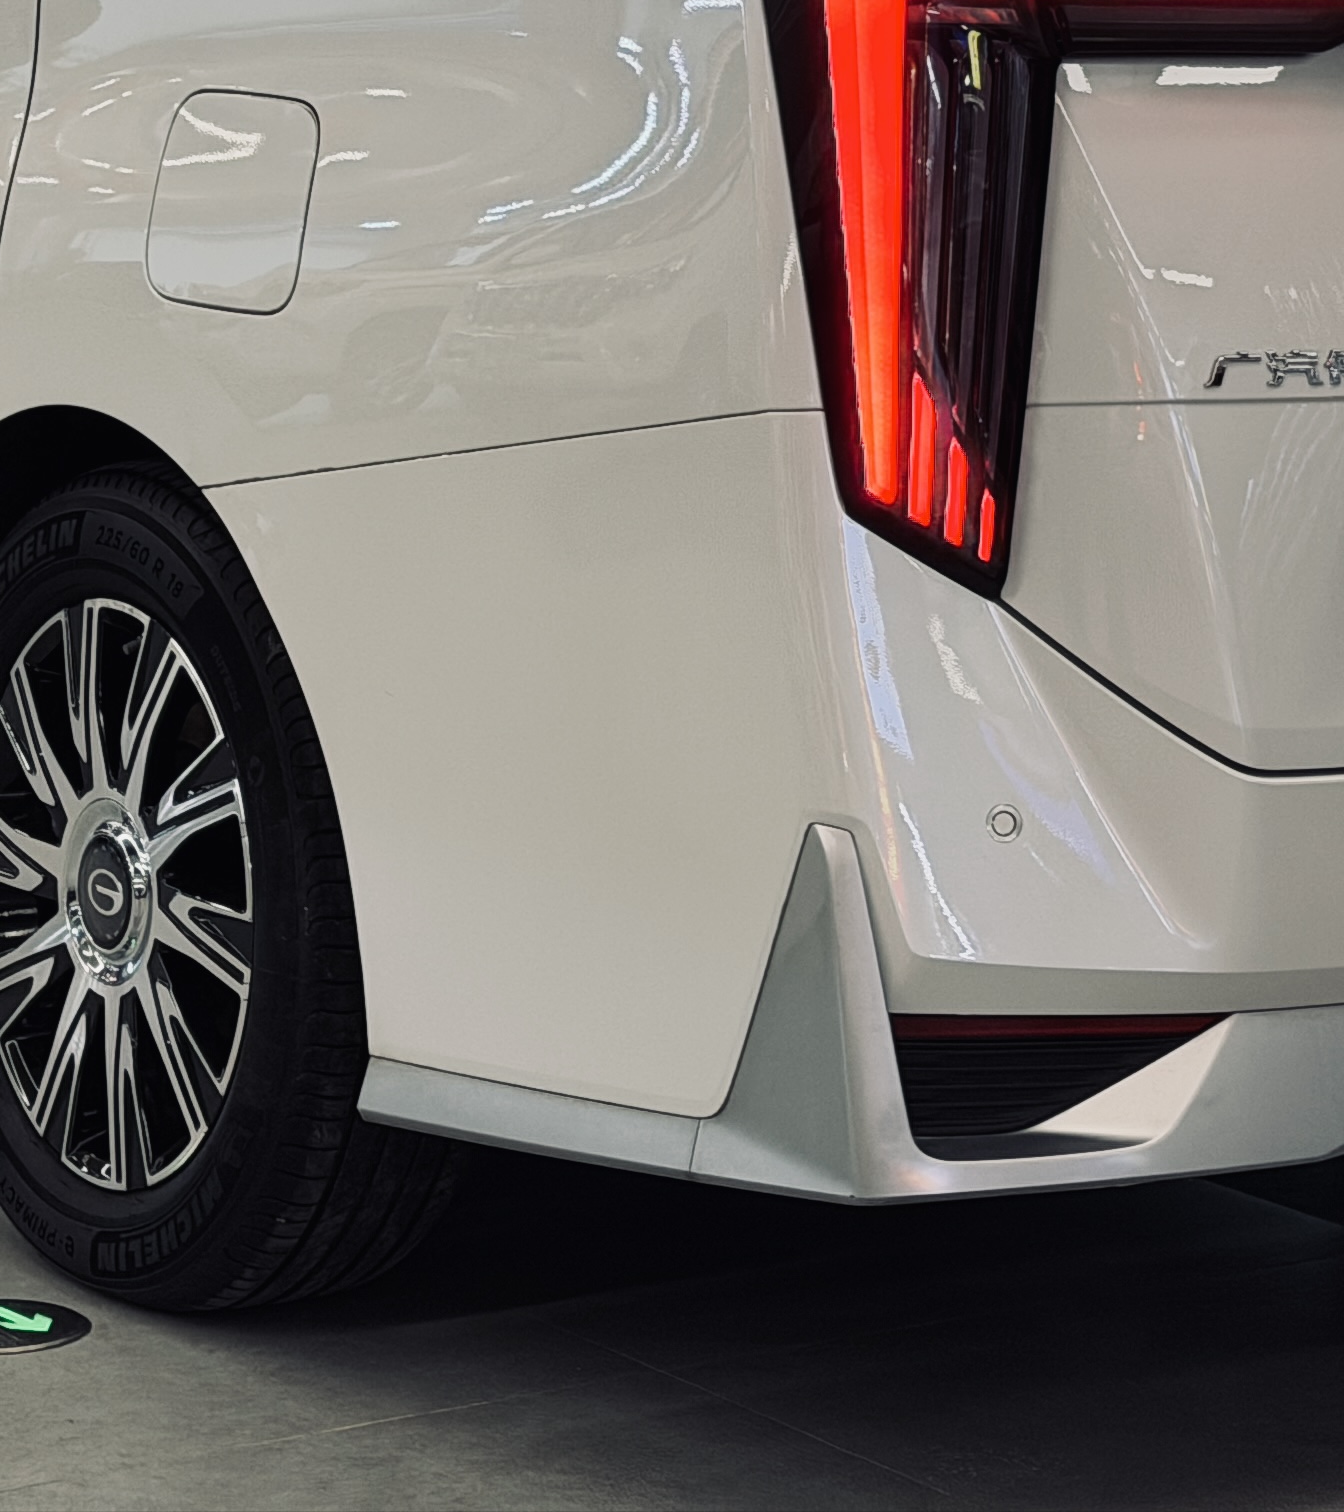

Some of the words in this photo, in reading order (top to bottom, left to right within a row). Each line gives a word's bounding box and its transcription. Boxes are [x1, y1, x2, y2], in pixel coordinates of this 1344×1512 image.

[95, 525, 150, 566] 225/60
[152, 558, 164, 579] R
[166, 572, 184, 599] 18
[96, 1167, 223, 1273] MICHELIN
